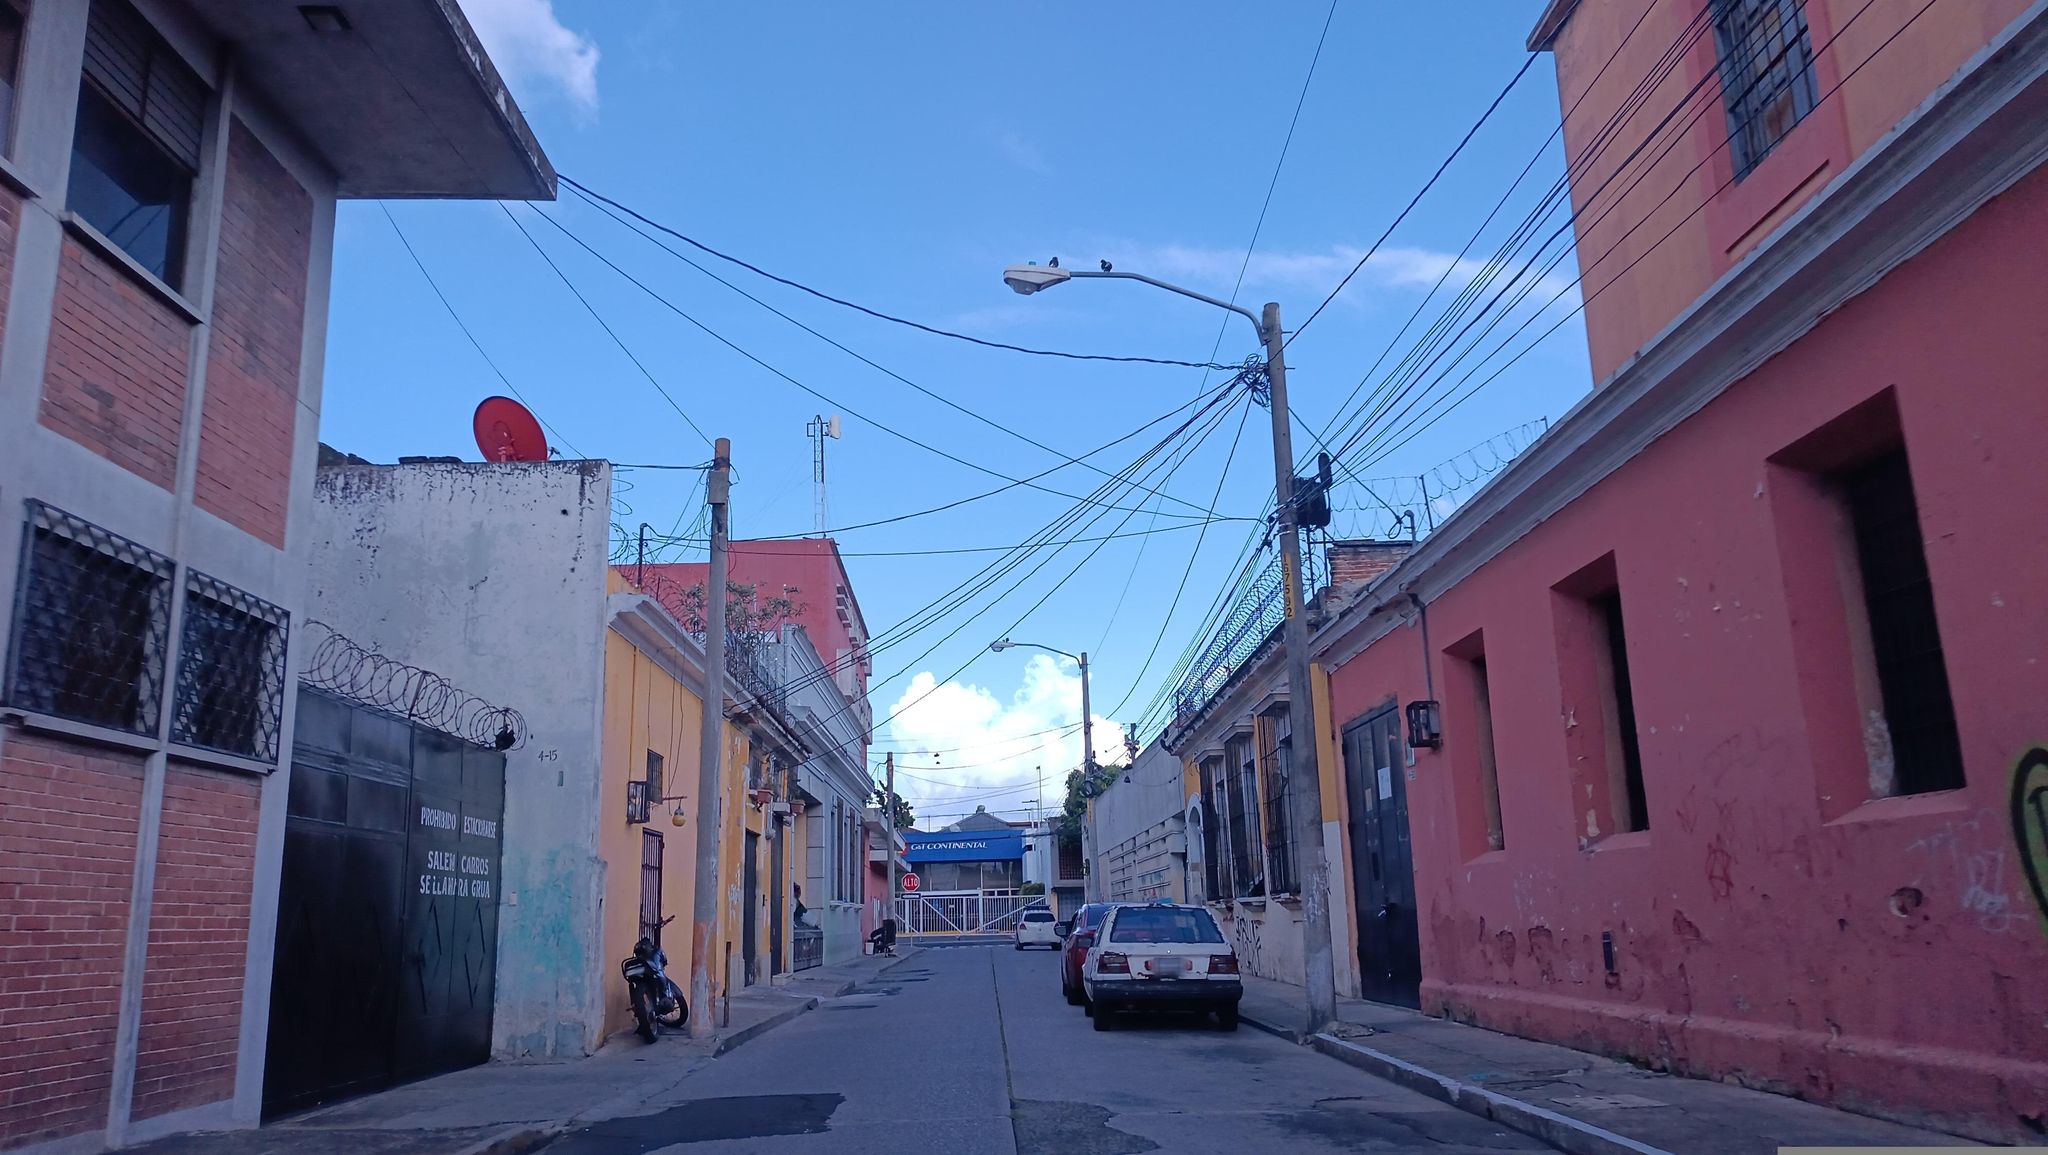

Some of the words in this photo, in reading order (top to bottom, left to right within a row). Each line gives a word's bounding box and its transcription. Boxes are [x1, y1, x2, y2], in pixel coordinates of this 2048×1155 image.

[538, 750, 557, 762] 4-15
[421, 807, 456, 830] PROHIBIDO
[927, 841, 987, 850] CONTINENTAL
[428, 851, 456, 872] SALEN
[462, 856, 488, 876] CARROS
[420, 875, 431, 895] SE
[472, 880, 490, 898] GRUA
[904, 878, 917, 887] ALTO
